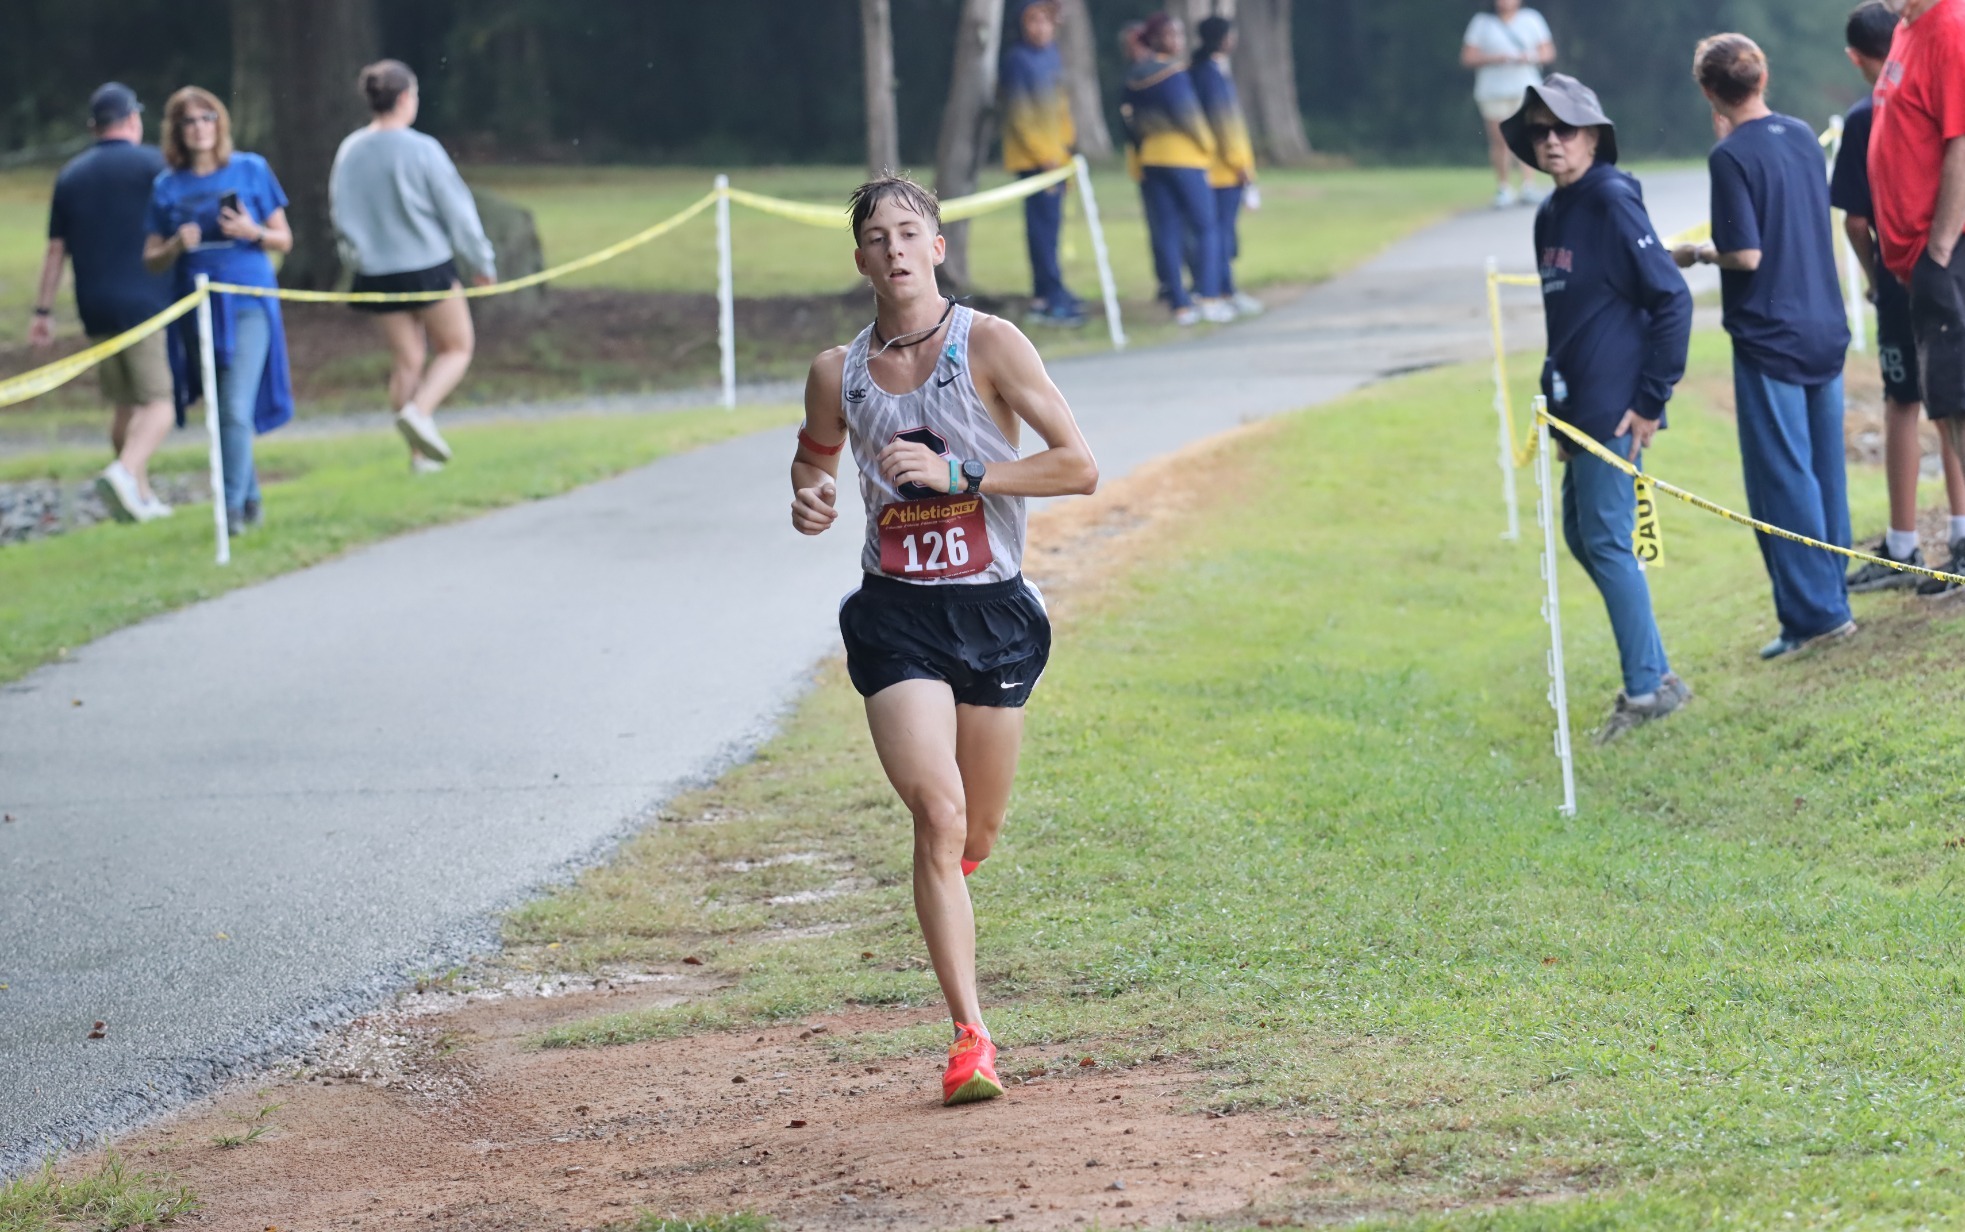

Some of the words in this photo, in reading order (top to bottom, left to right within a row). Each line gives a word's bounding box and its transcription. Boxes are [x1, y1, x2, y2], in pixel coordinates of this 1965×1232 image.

[848, 388, 867, 400] SAC
[953, 502, 976, 514] NET
[902, 526, 969, 573] 126
